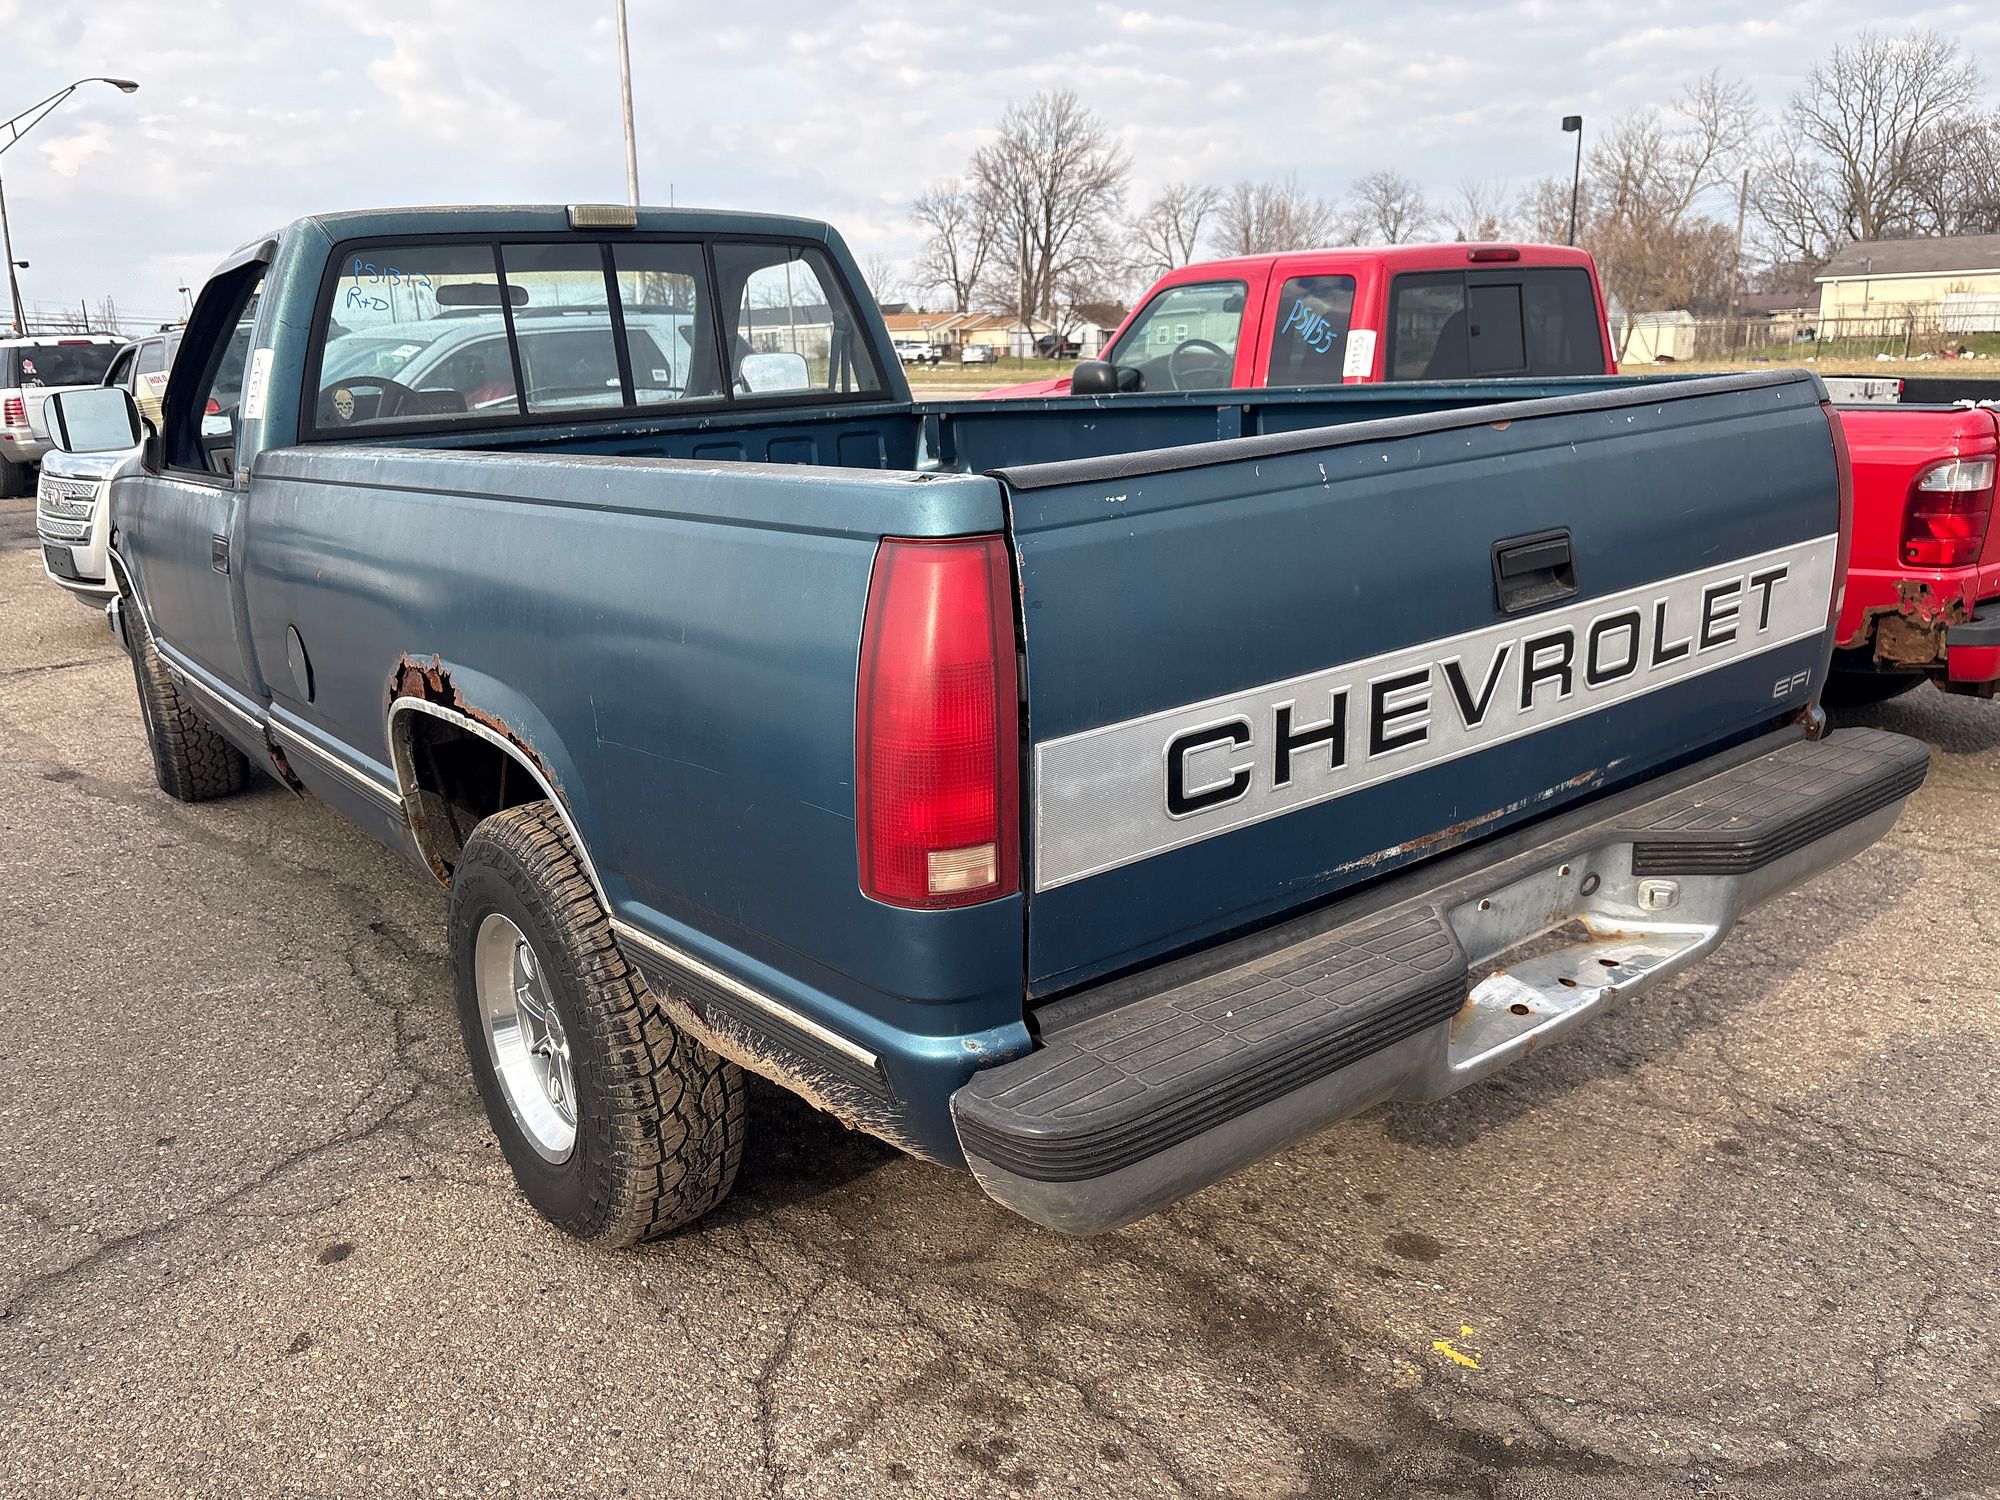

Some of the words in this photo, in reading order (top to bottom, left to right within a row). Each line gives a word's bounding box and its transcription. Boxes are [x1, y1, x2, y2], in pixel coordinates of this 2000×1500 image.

[1281, 297, 1338, 354] PS1155
[148, 374, 168, 385] HOLD
[1164, 562, 1790, 819] CHEVROLET
[1773, 667, 1812, 699] EFI
